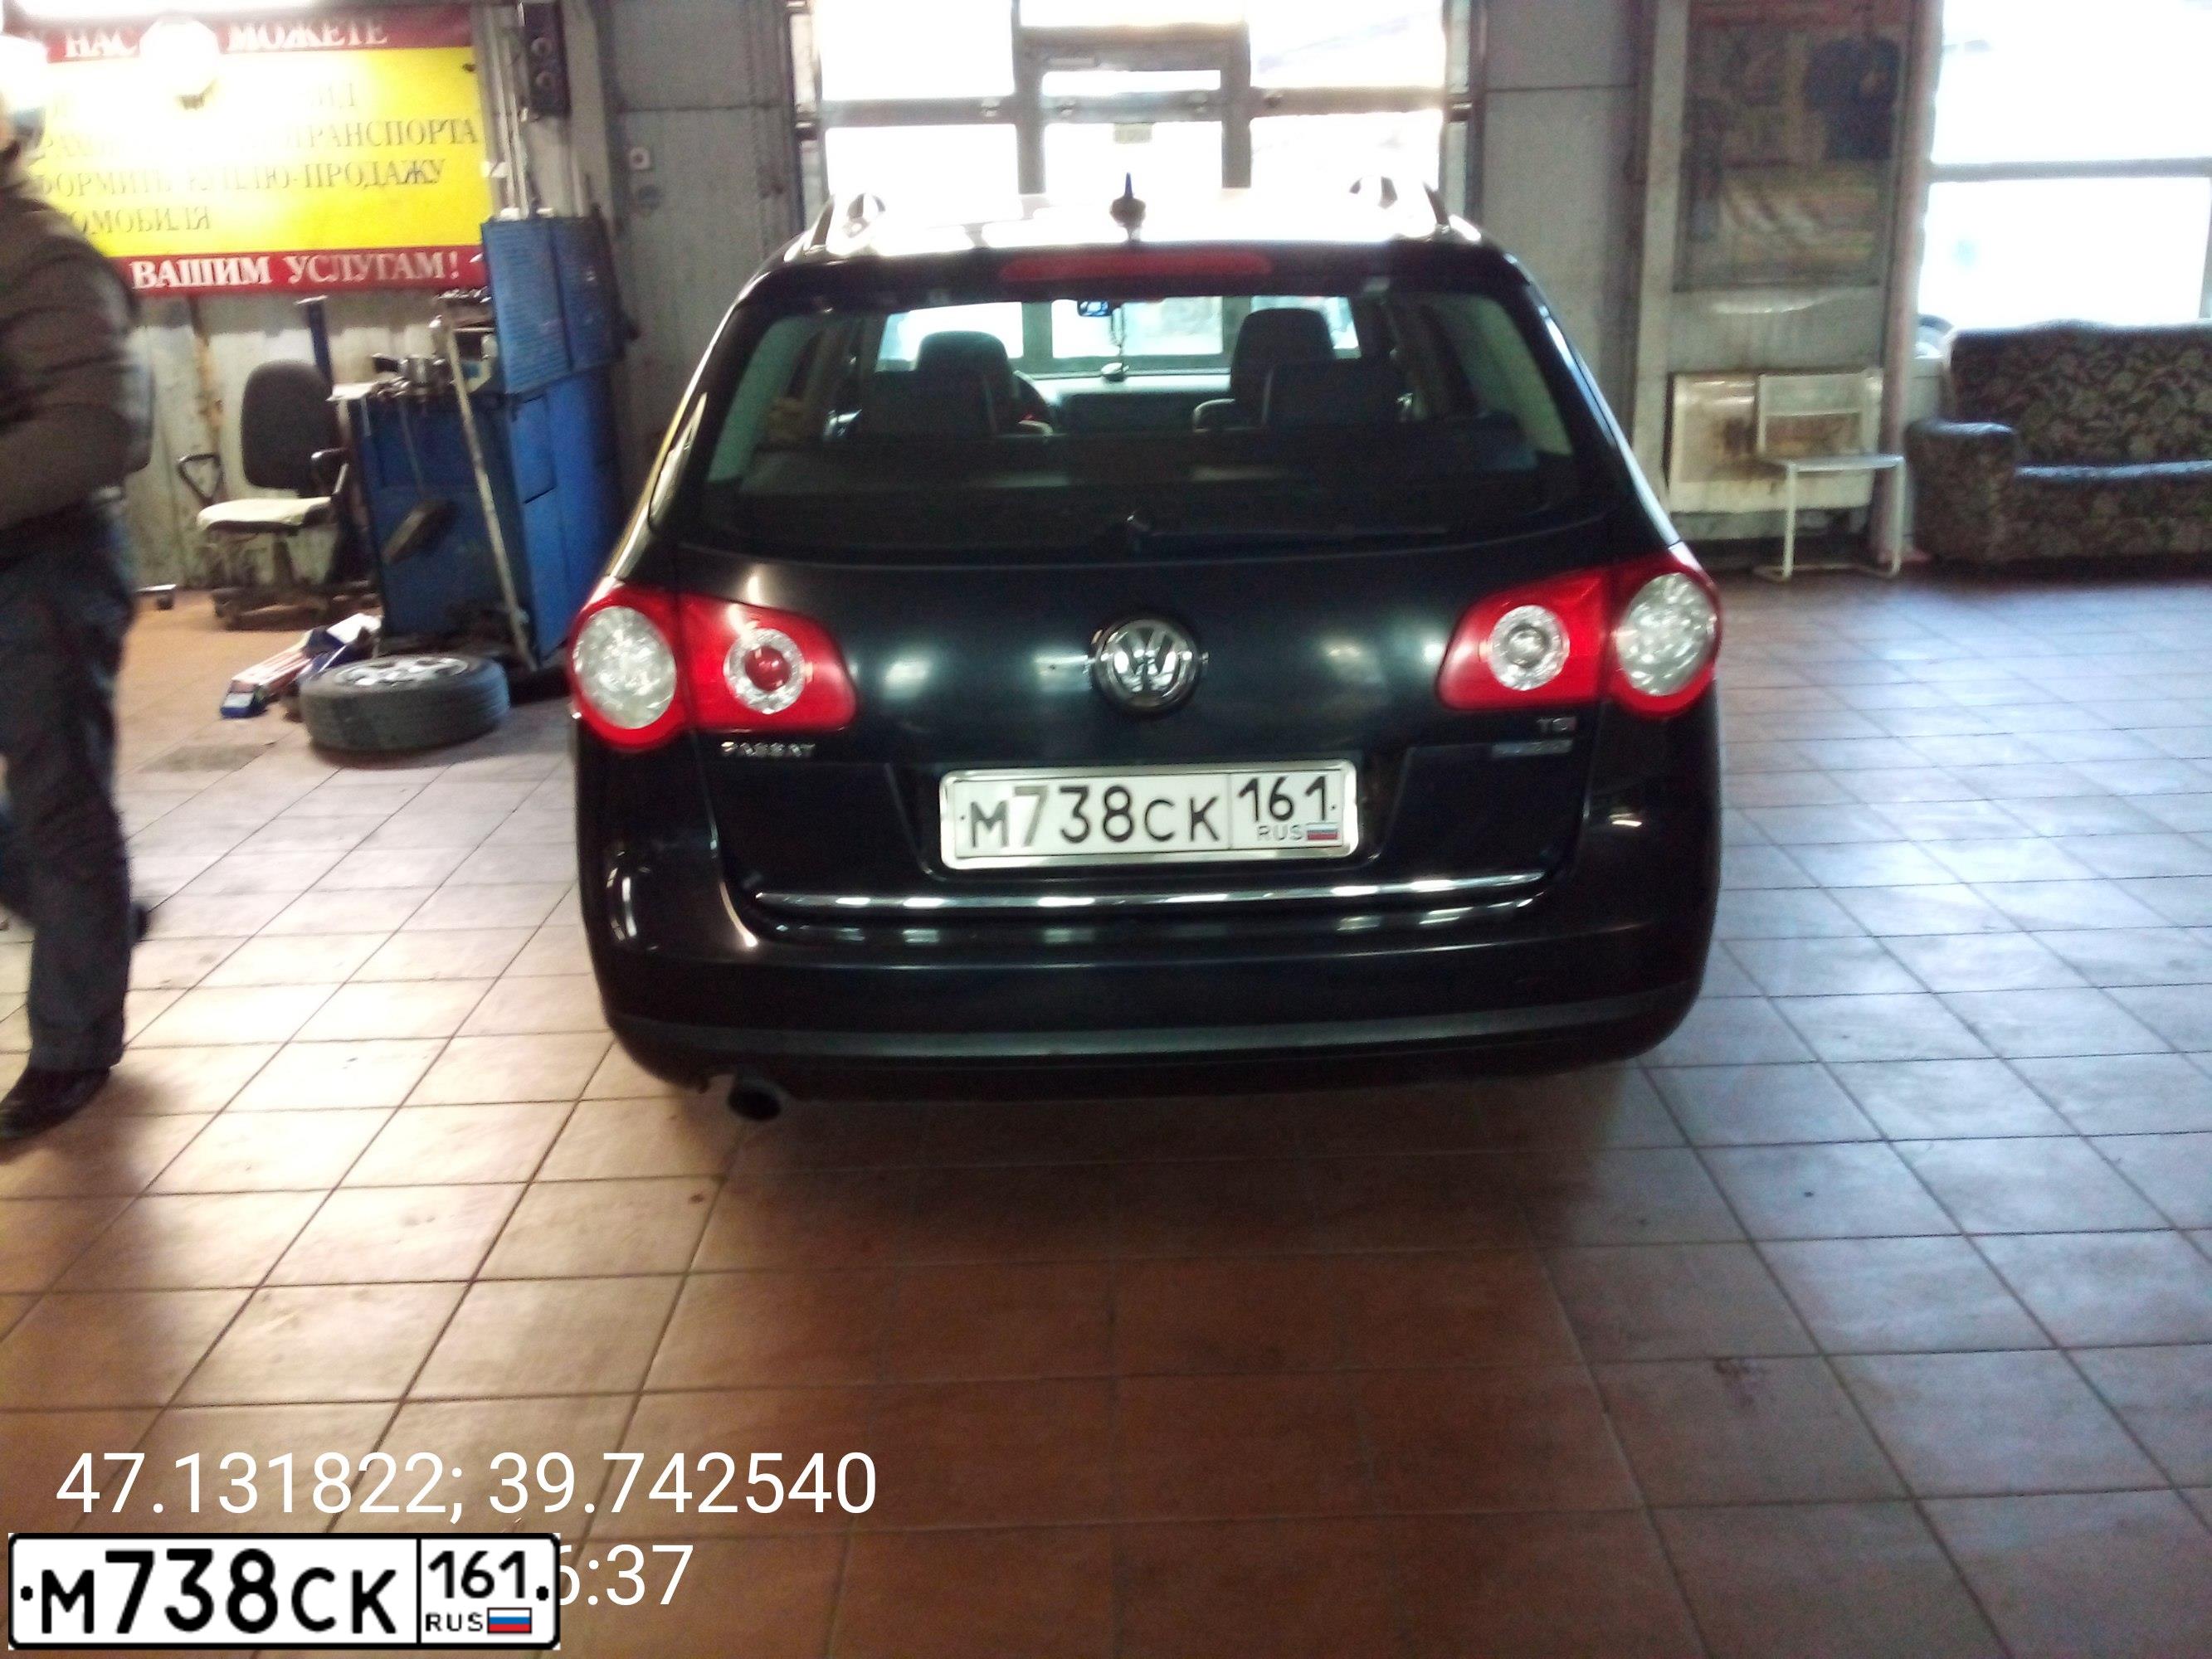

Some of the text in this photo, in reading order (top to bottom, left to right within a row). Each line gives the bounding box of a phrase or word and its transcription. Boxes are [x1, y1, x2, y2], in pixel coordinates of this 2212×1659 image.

[70, 205, 211, 235] ОМОБИЛЯ
[130, 251, 460, 290] ВАШИМ УСЛУГАМ!
[1239, 775, 1328, 822] 161
[1257, 824, 1303, 841] RUS
